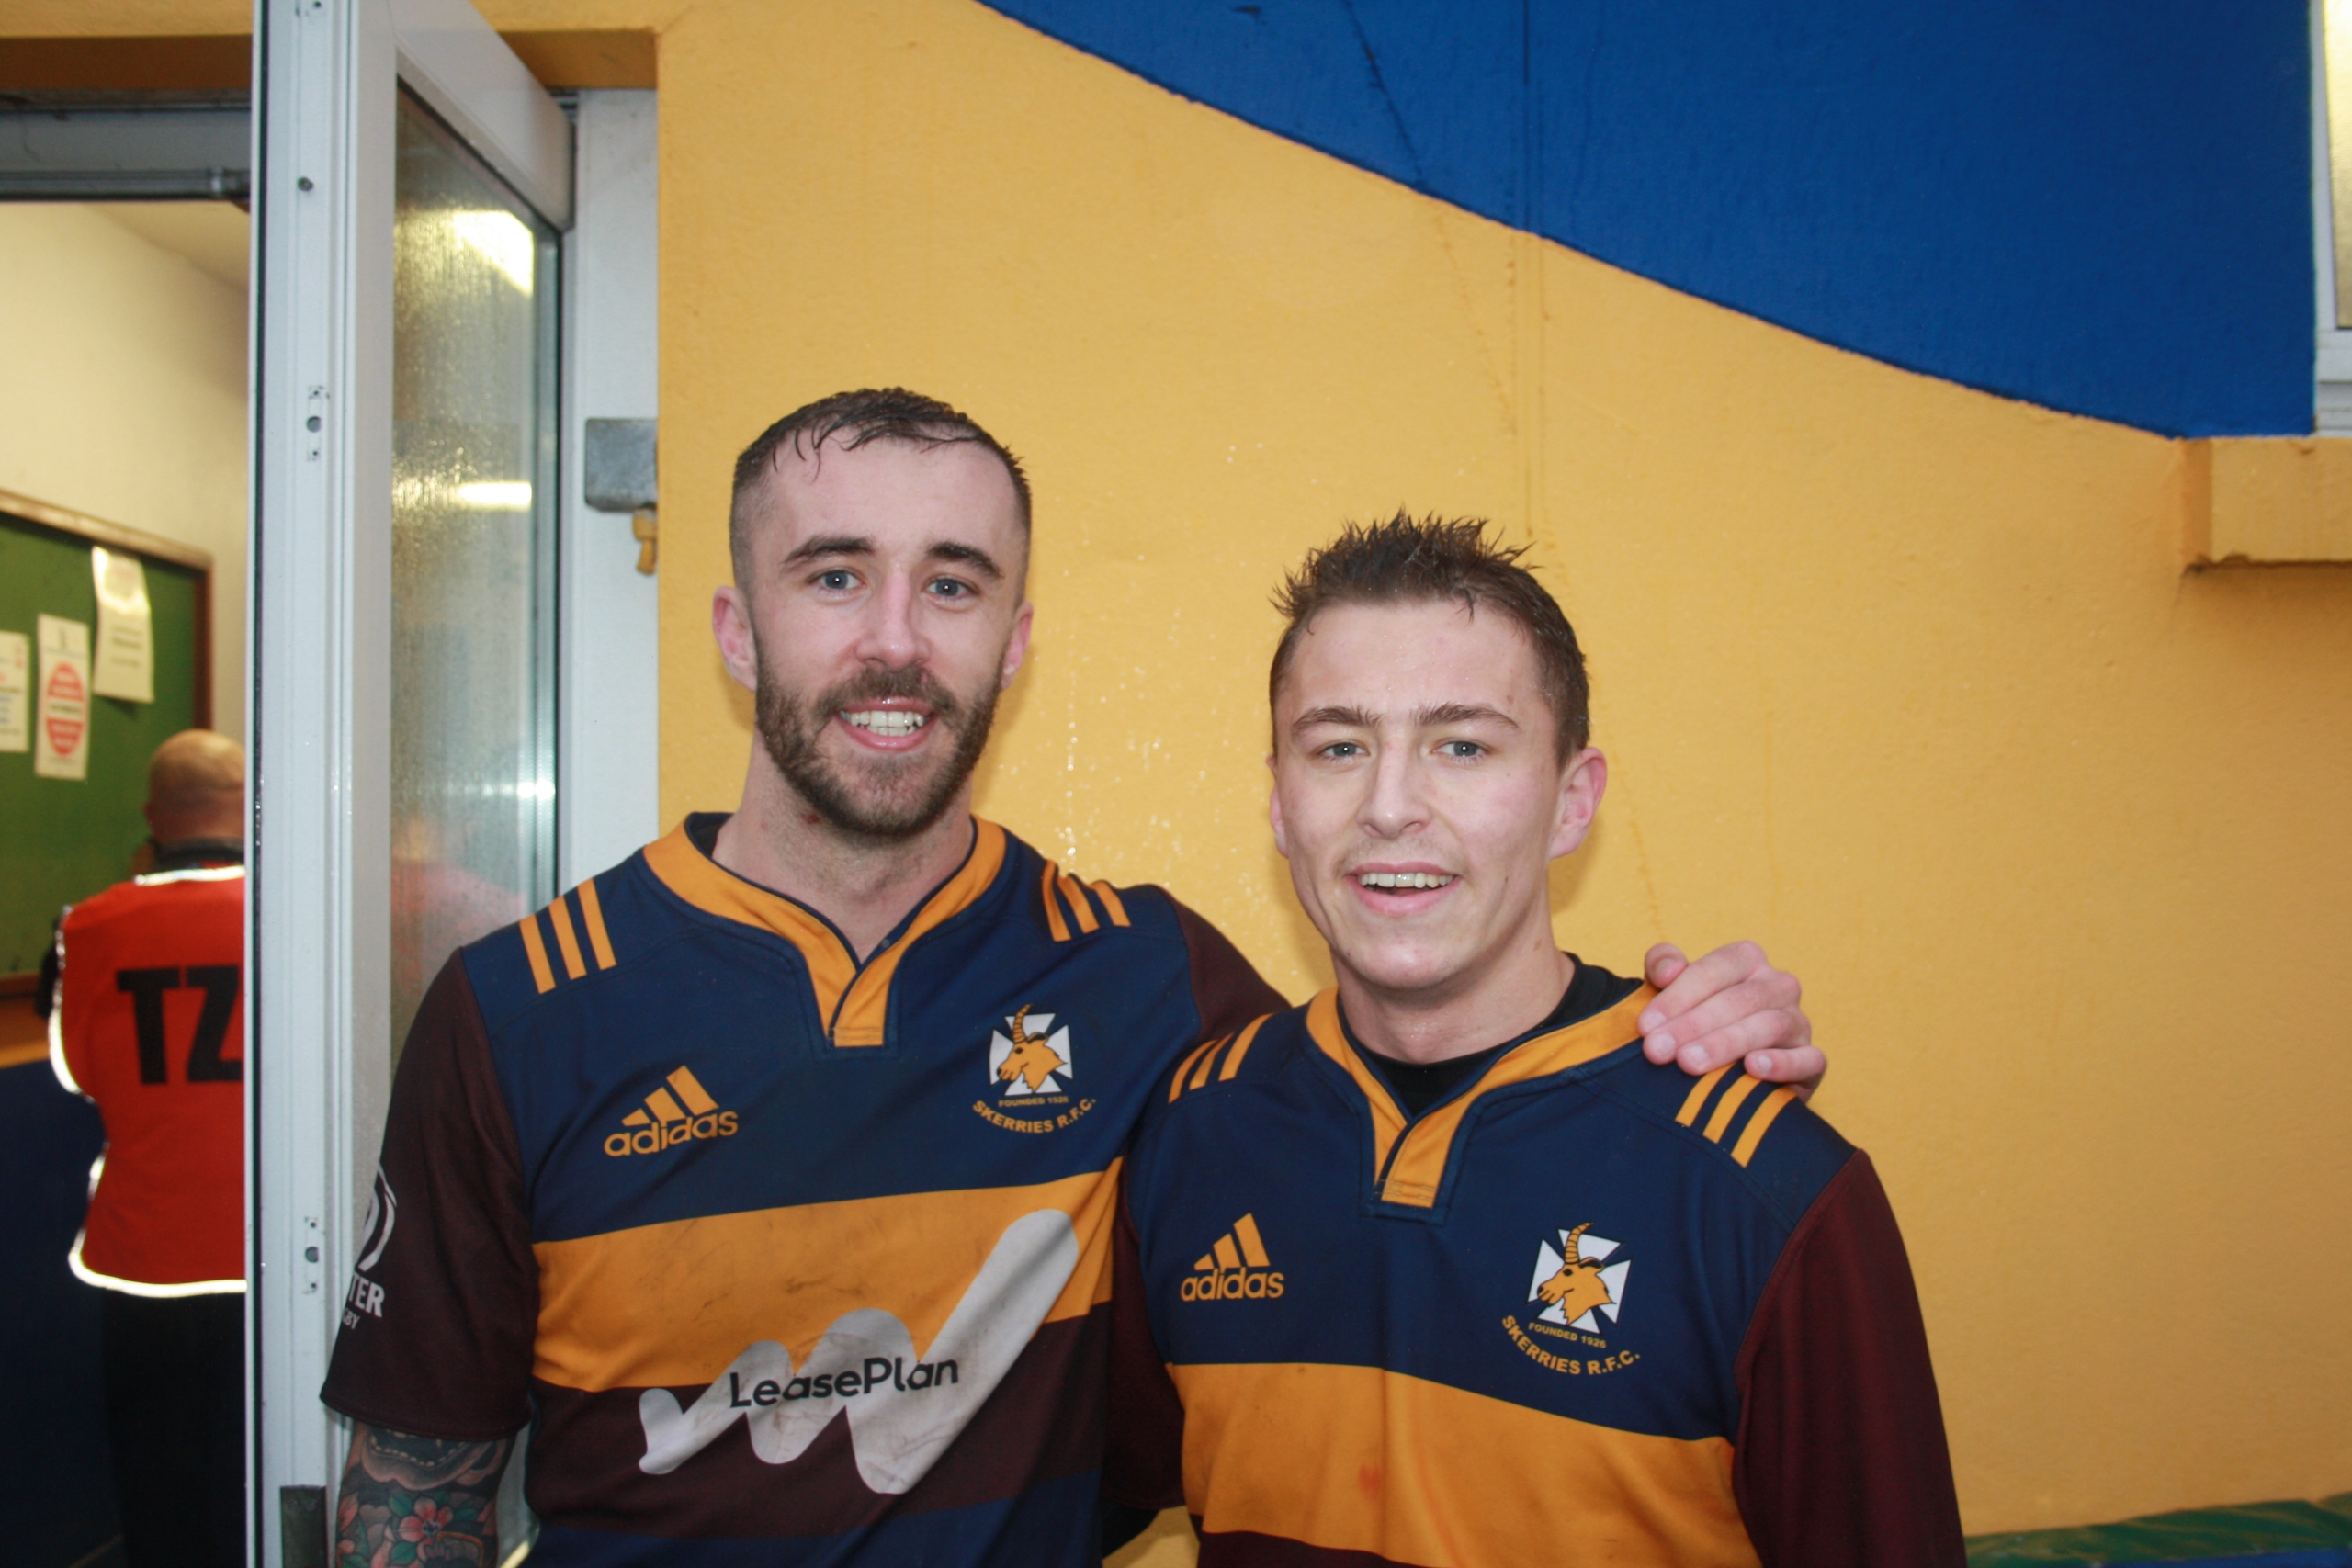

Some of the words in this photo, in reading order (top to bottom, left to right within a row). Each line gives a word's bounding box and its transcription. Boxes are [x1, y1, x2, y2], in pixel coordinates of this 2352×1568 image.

[972, 1100, 1054, 1134] SKERRIES
[1057, 1099, 1096, 1128] R.F.C.
[998, 1097, 1046, 1108] FOUNDED
[1046, 1096, 1069, 1105] 1926
[604, 1111, 739, 1157] adidas
[1180, 1267, 1285, 1302] adidas
[1502, 1315, 1581, 1375] SKERRIES
[1587, 1349, 1641, 1376] R.F.C.
[1528, 1322, 1578, 1342] FOUNDED
[1581, 1335, 1607, 1349] 1926
[729, 1357, 959, 1408] LeasePlan
